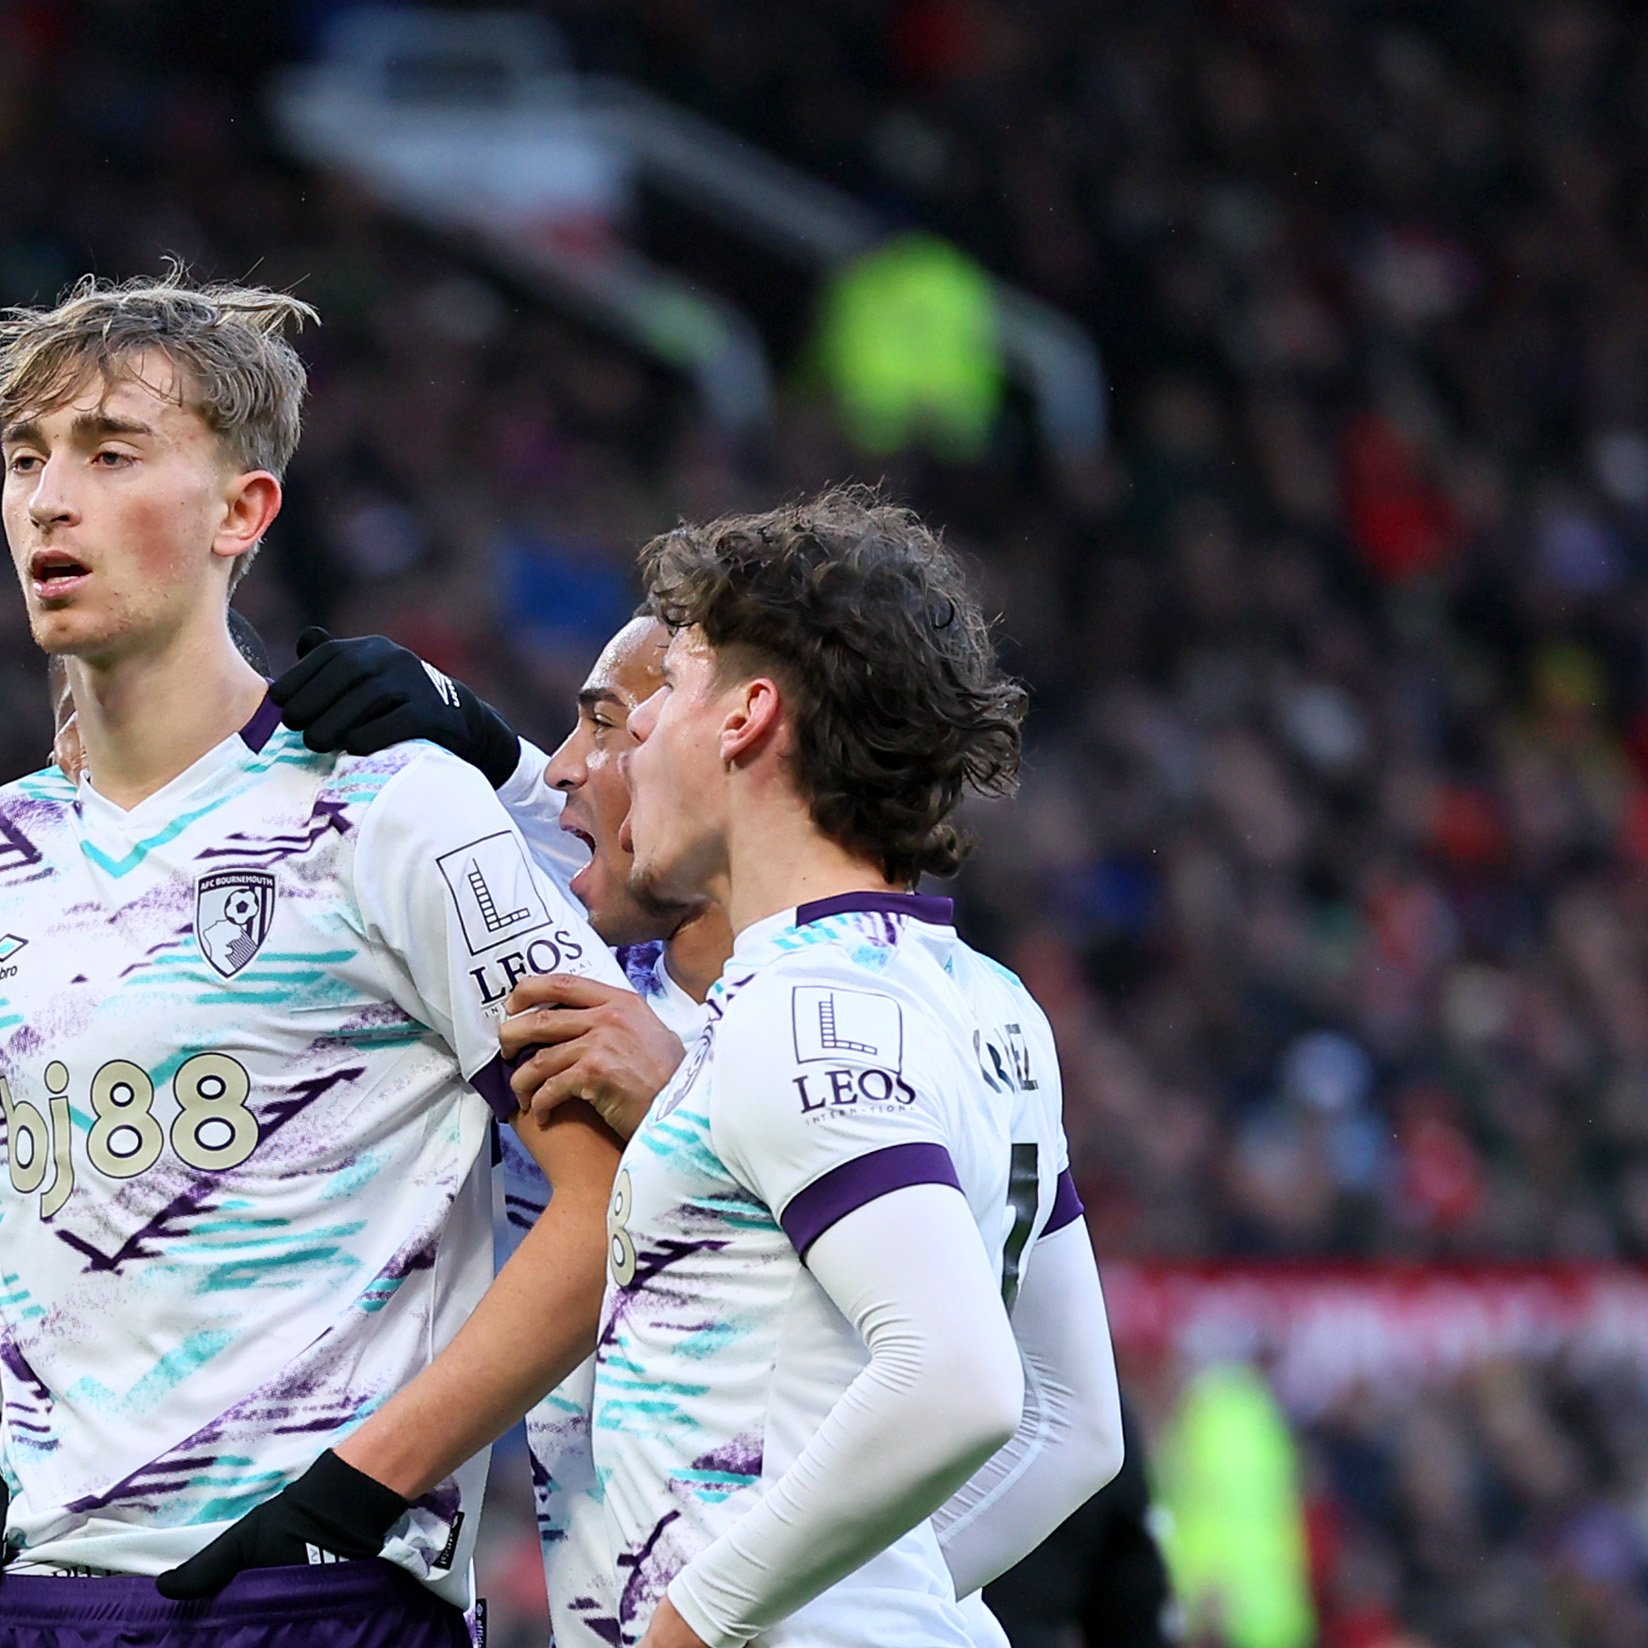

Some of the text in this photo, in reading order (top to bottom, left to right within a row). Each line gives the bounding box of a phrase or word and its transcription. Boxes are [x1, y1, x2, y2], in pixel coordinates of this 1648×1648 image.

[200, 874, 273, 891] AFC BOURNEMOUTH
[792, 1069, 916, 1115] LEOS
